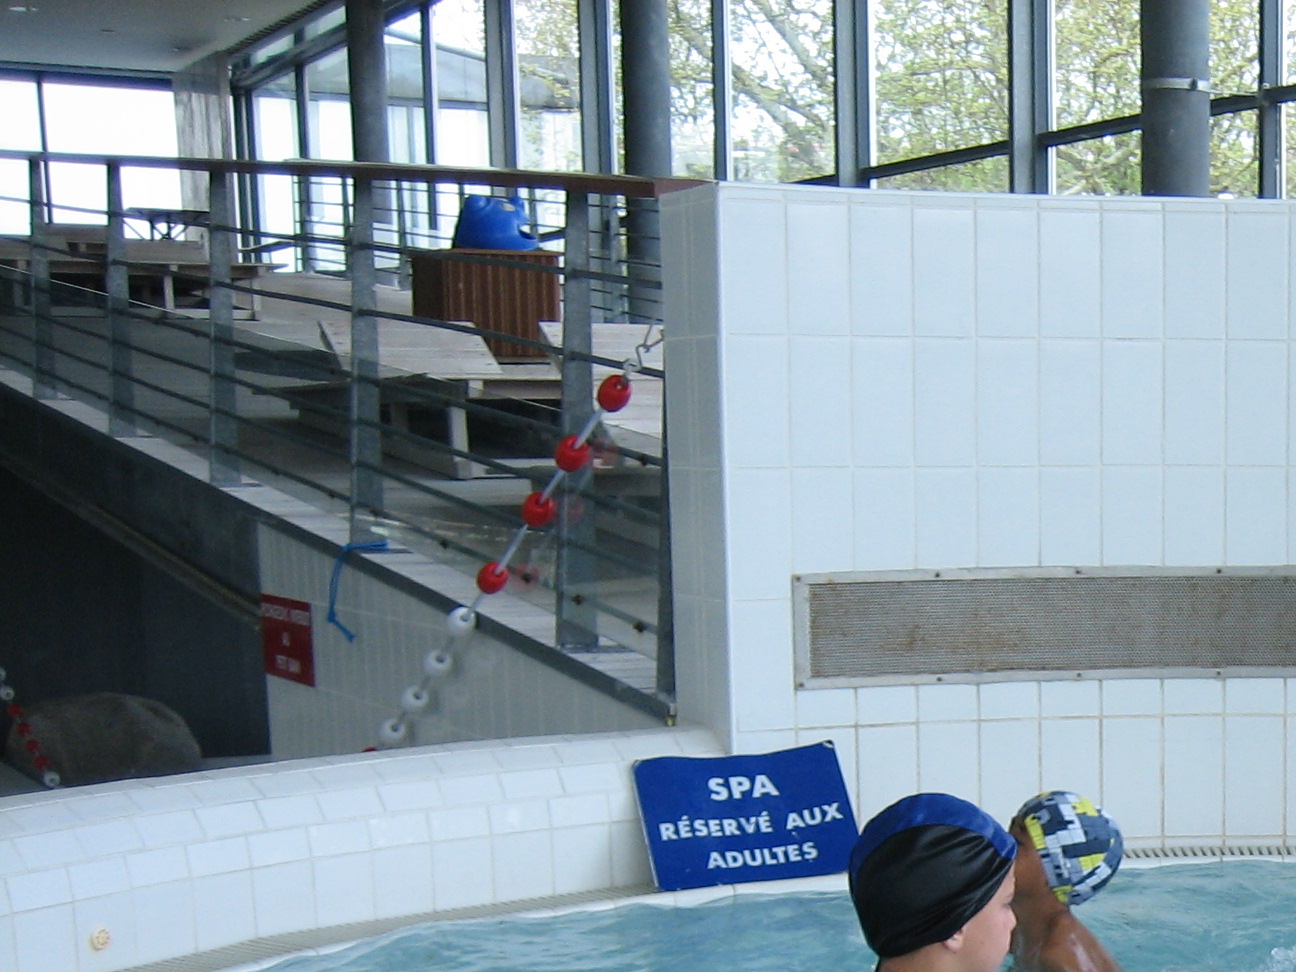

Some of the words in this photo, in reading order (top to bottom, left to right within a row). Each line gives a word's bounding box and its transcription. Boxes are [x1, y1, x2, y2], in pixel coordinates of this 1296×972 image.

[707, 774, 780, 801] SPA
[658, 811, 773, 841] RÉSERVÉ
[786, 802, 844, 831] AUX
[706, 841, 819, 870] ADULTES
